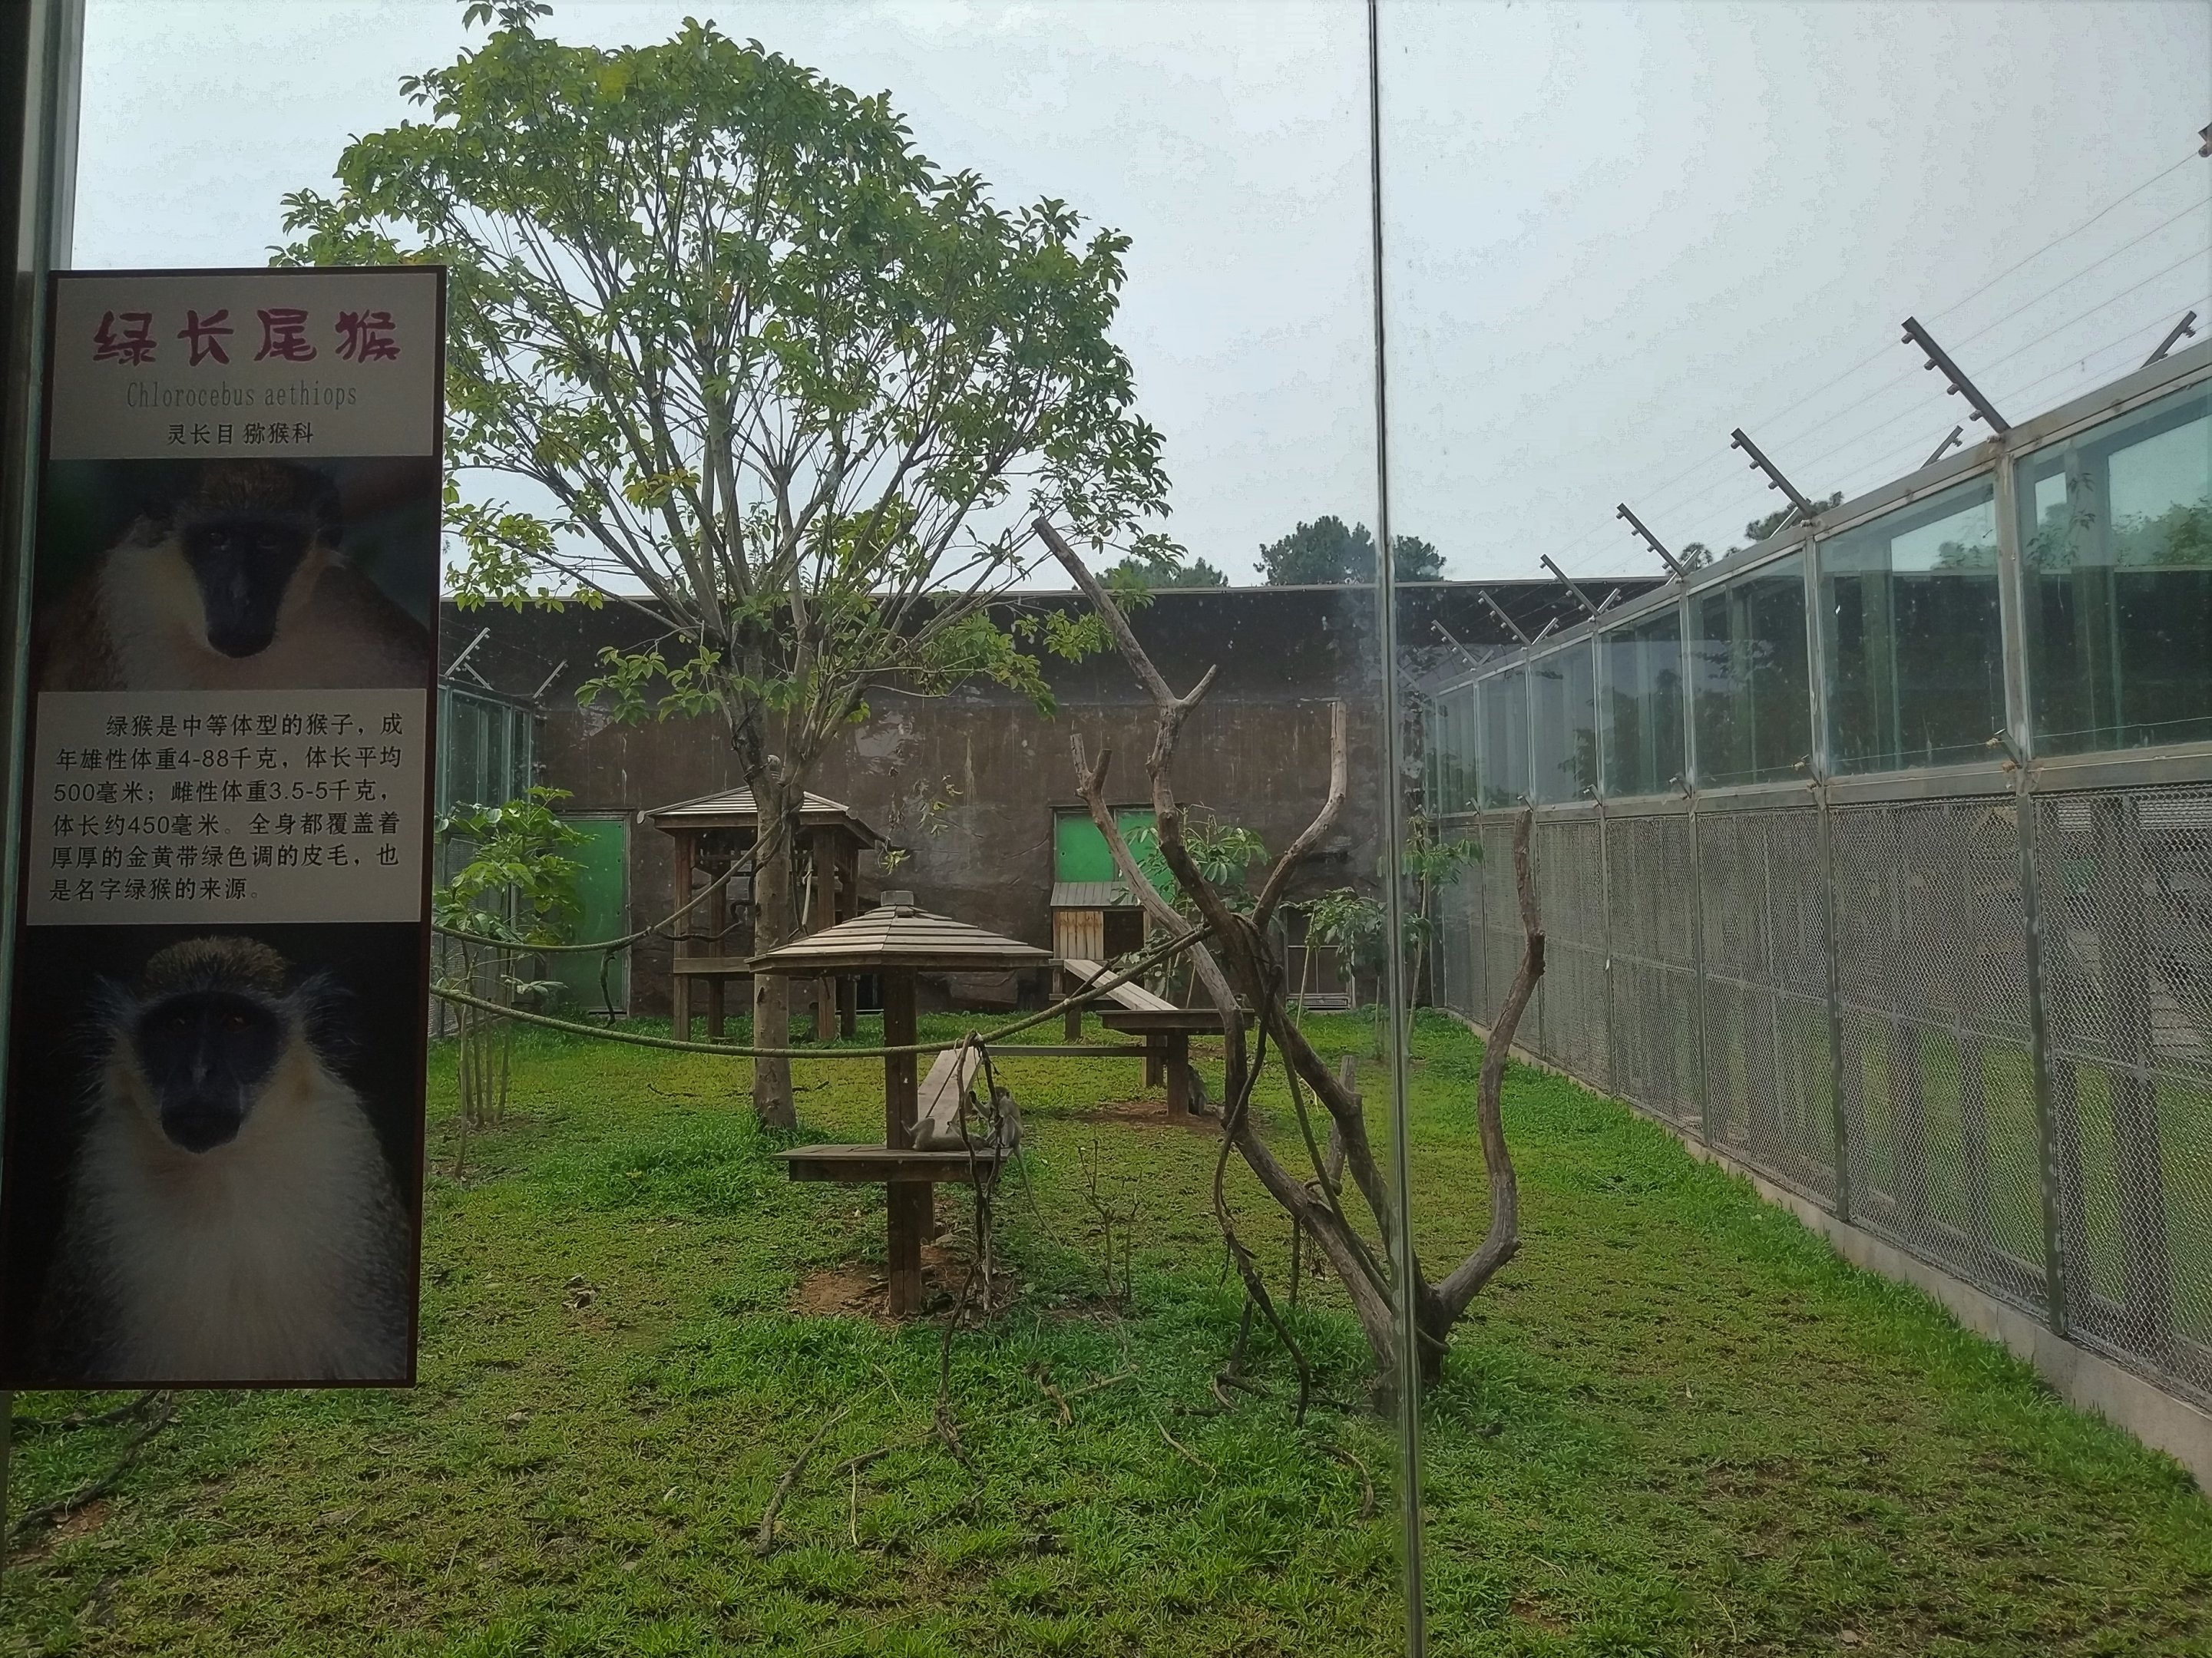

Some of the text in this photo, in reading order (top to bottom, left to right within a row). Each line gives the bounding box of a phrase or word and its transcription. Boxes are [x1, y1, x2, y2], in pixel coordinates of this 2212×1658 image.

[92, 308, 402, 367] 绿长尾猴
[127, 380, 357, 410] Chlorocebus aethiops
[167, 421, 314, 445] 灵长目 猕猴科
[106, 712, 403, 738] 绿猴是中等体型的猴子，成
[55, 745, 402, 771] 年雄性体重4-88千克，体长平均
[51, 811, 399, 837] 体长约450毫米。全身都覆盖着
[49, 843, 399, 870] 厚厚的金黄带绿色调的皮毛，也
[49, 877, 259, 902] 是名字绿猴的来源。
